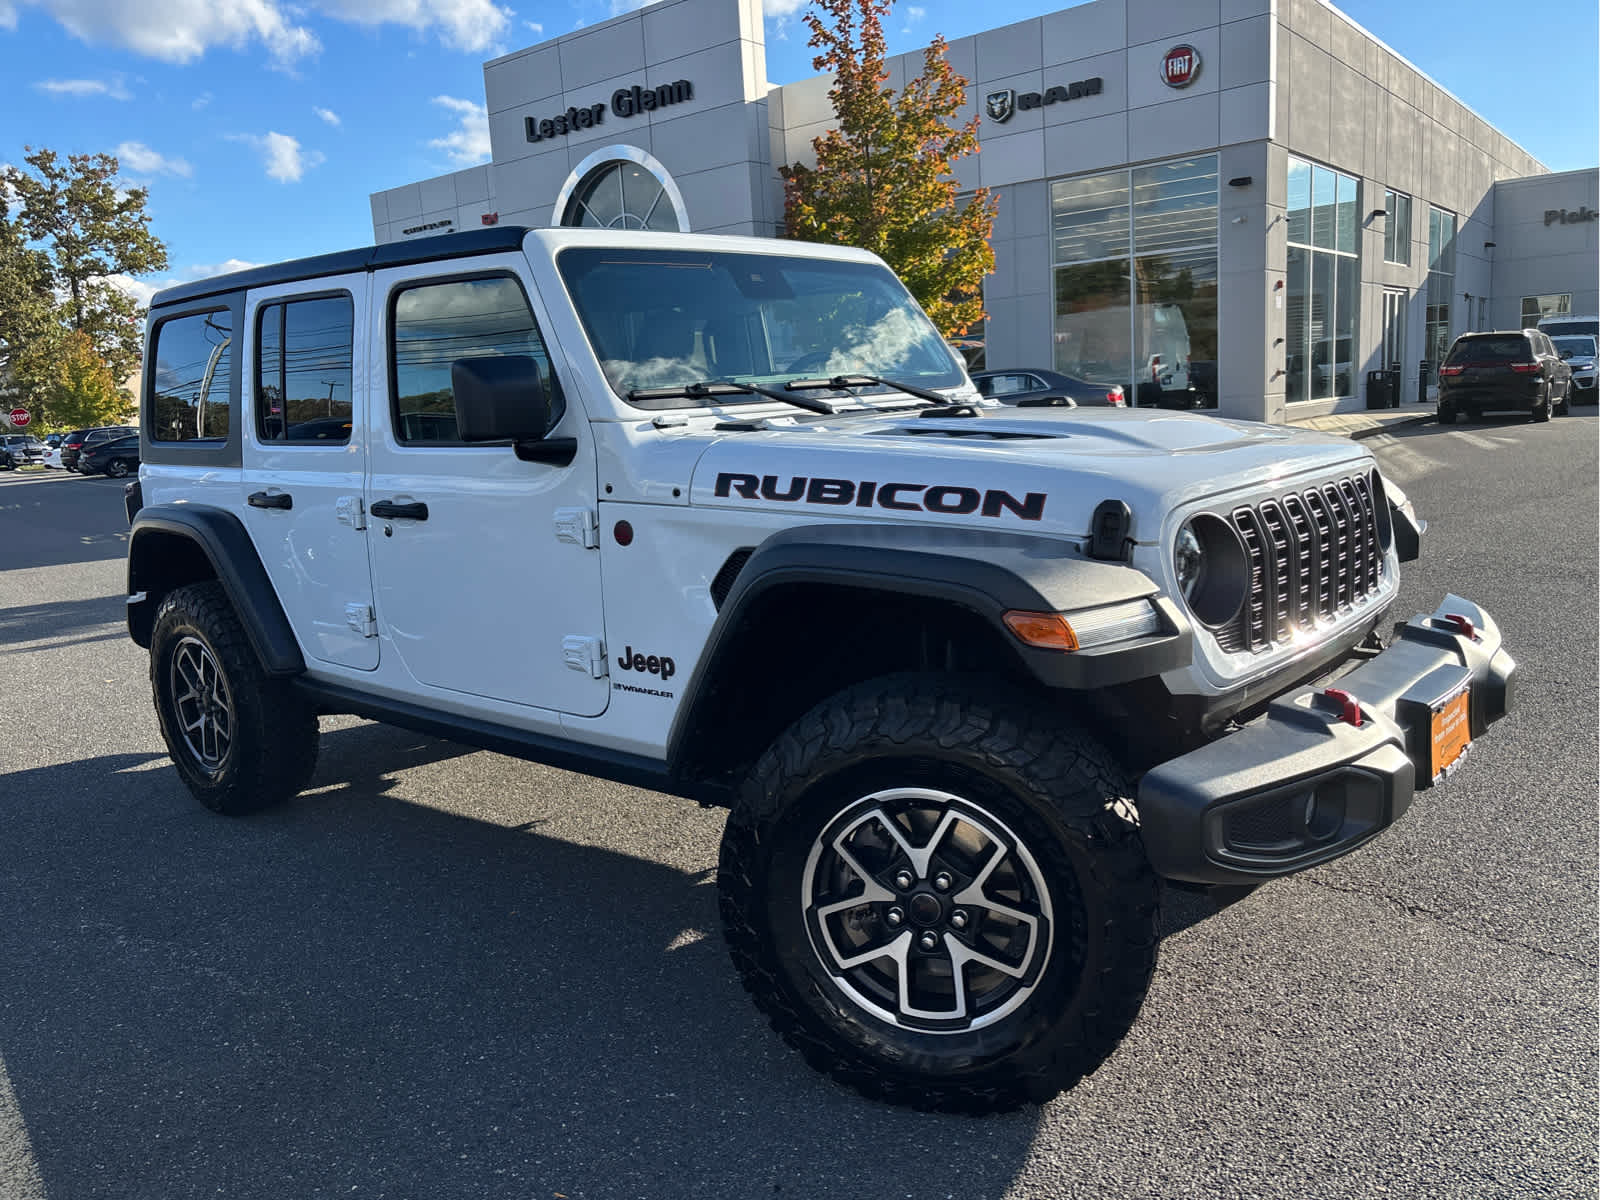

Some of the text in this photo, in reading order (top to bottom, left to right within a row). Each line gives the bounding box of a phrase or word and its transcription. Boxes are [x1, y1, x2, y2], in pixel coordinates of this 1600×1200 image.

[1168, 55, 1191, 77] FIAT
[524, 79, 694, 143] Lester Glenn
[1017, 77, 1104, 111] RAM
[10, 413, 28, 422] STOP
[714, 472, 1048, 521] RUBICON
[617, 646, 675, 680] Jeep
[622, 684, 674, 698] WRANGLER
